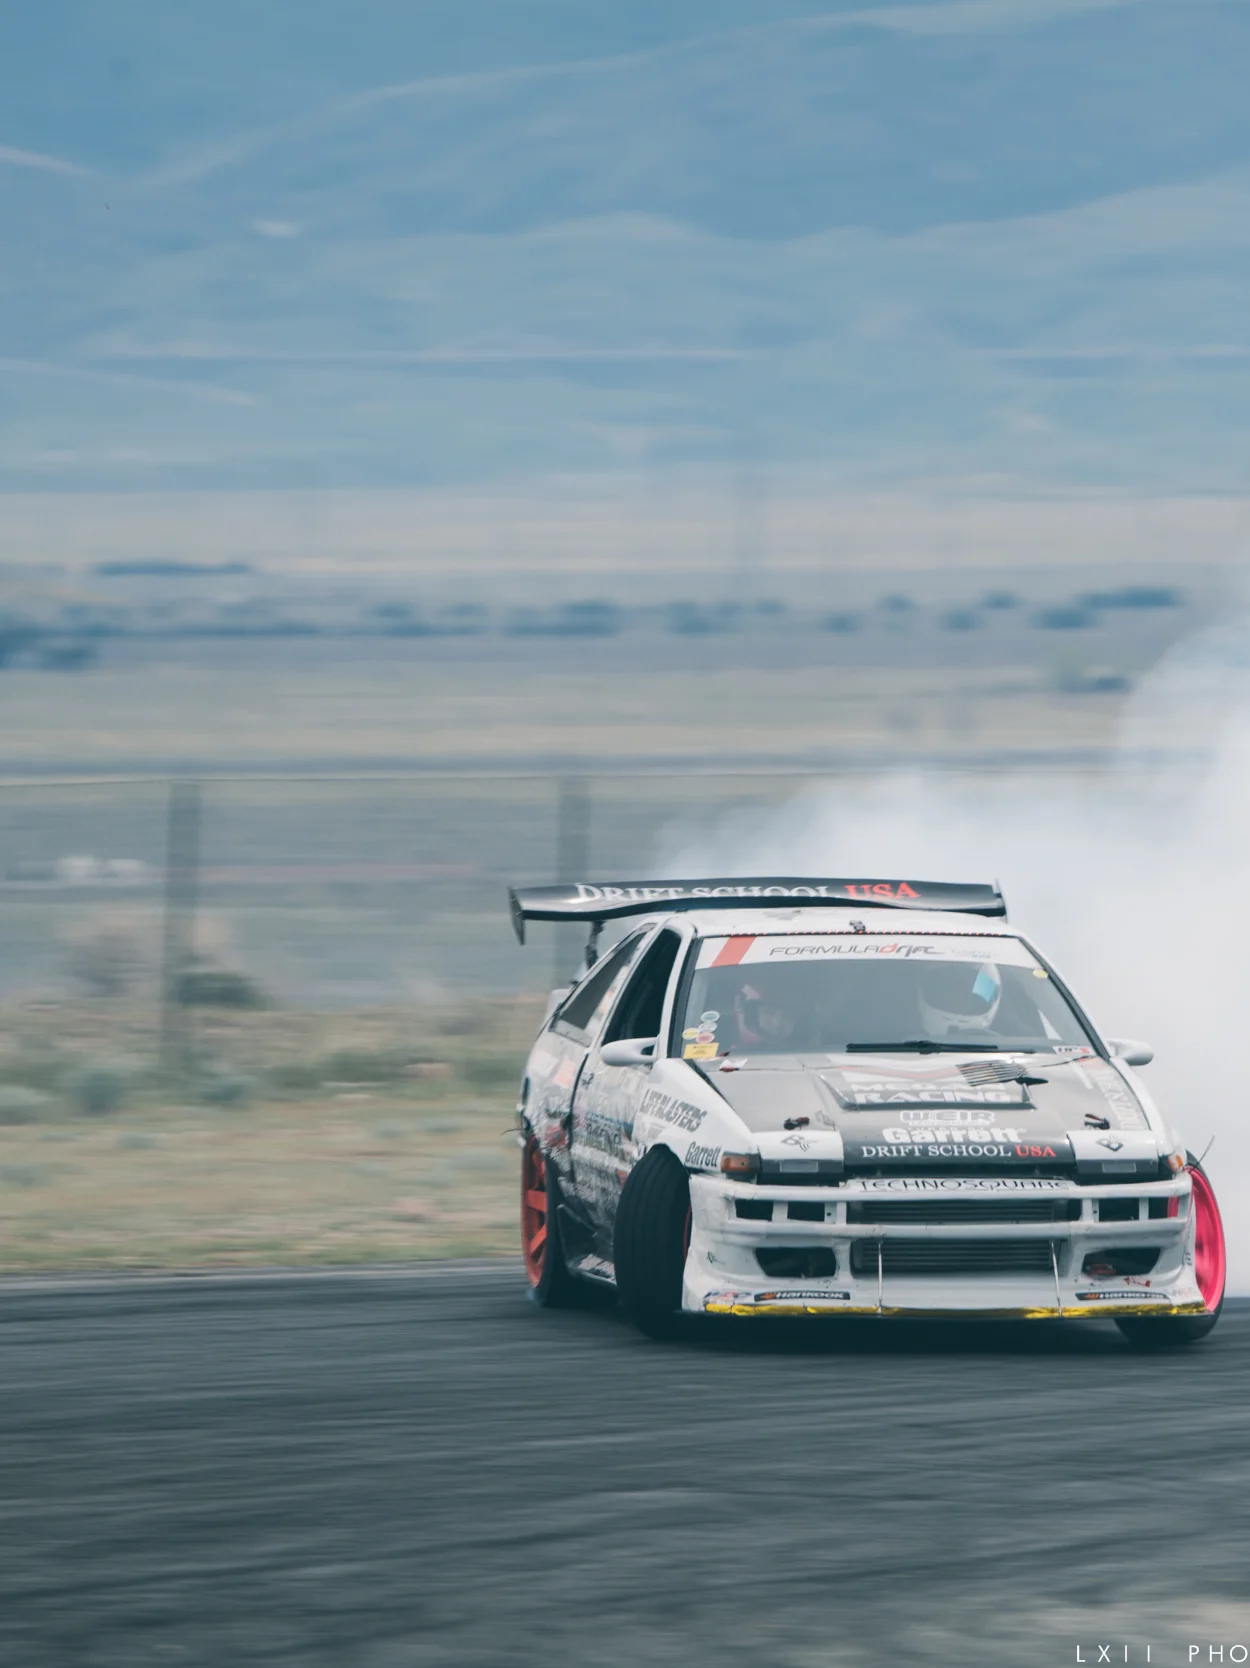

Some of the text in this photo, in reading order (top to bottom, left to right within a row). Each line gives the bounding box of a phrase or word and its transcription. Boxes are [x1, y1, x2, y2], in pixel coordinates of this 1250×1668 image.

[575, 882, 920, 902] DRIFT SCHOOL USA
[854, 1090, 1011, 1104] RACING
[882, 1127, 1022, 1143] Garrett
[685, 1141, 721, 1168] Garrett
[861, 1144, 1056, 1158] DRIFT SCHOOL USA
